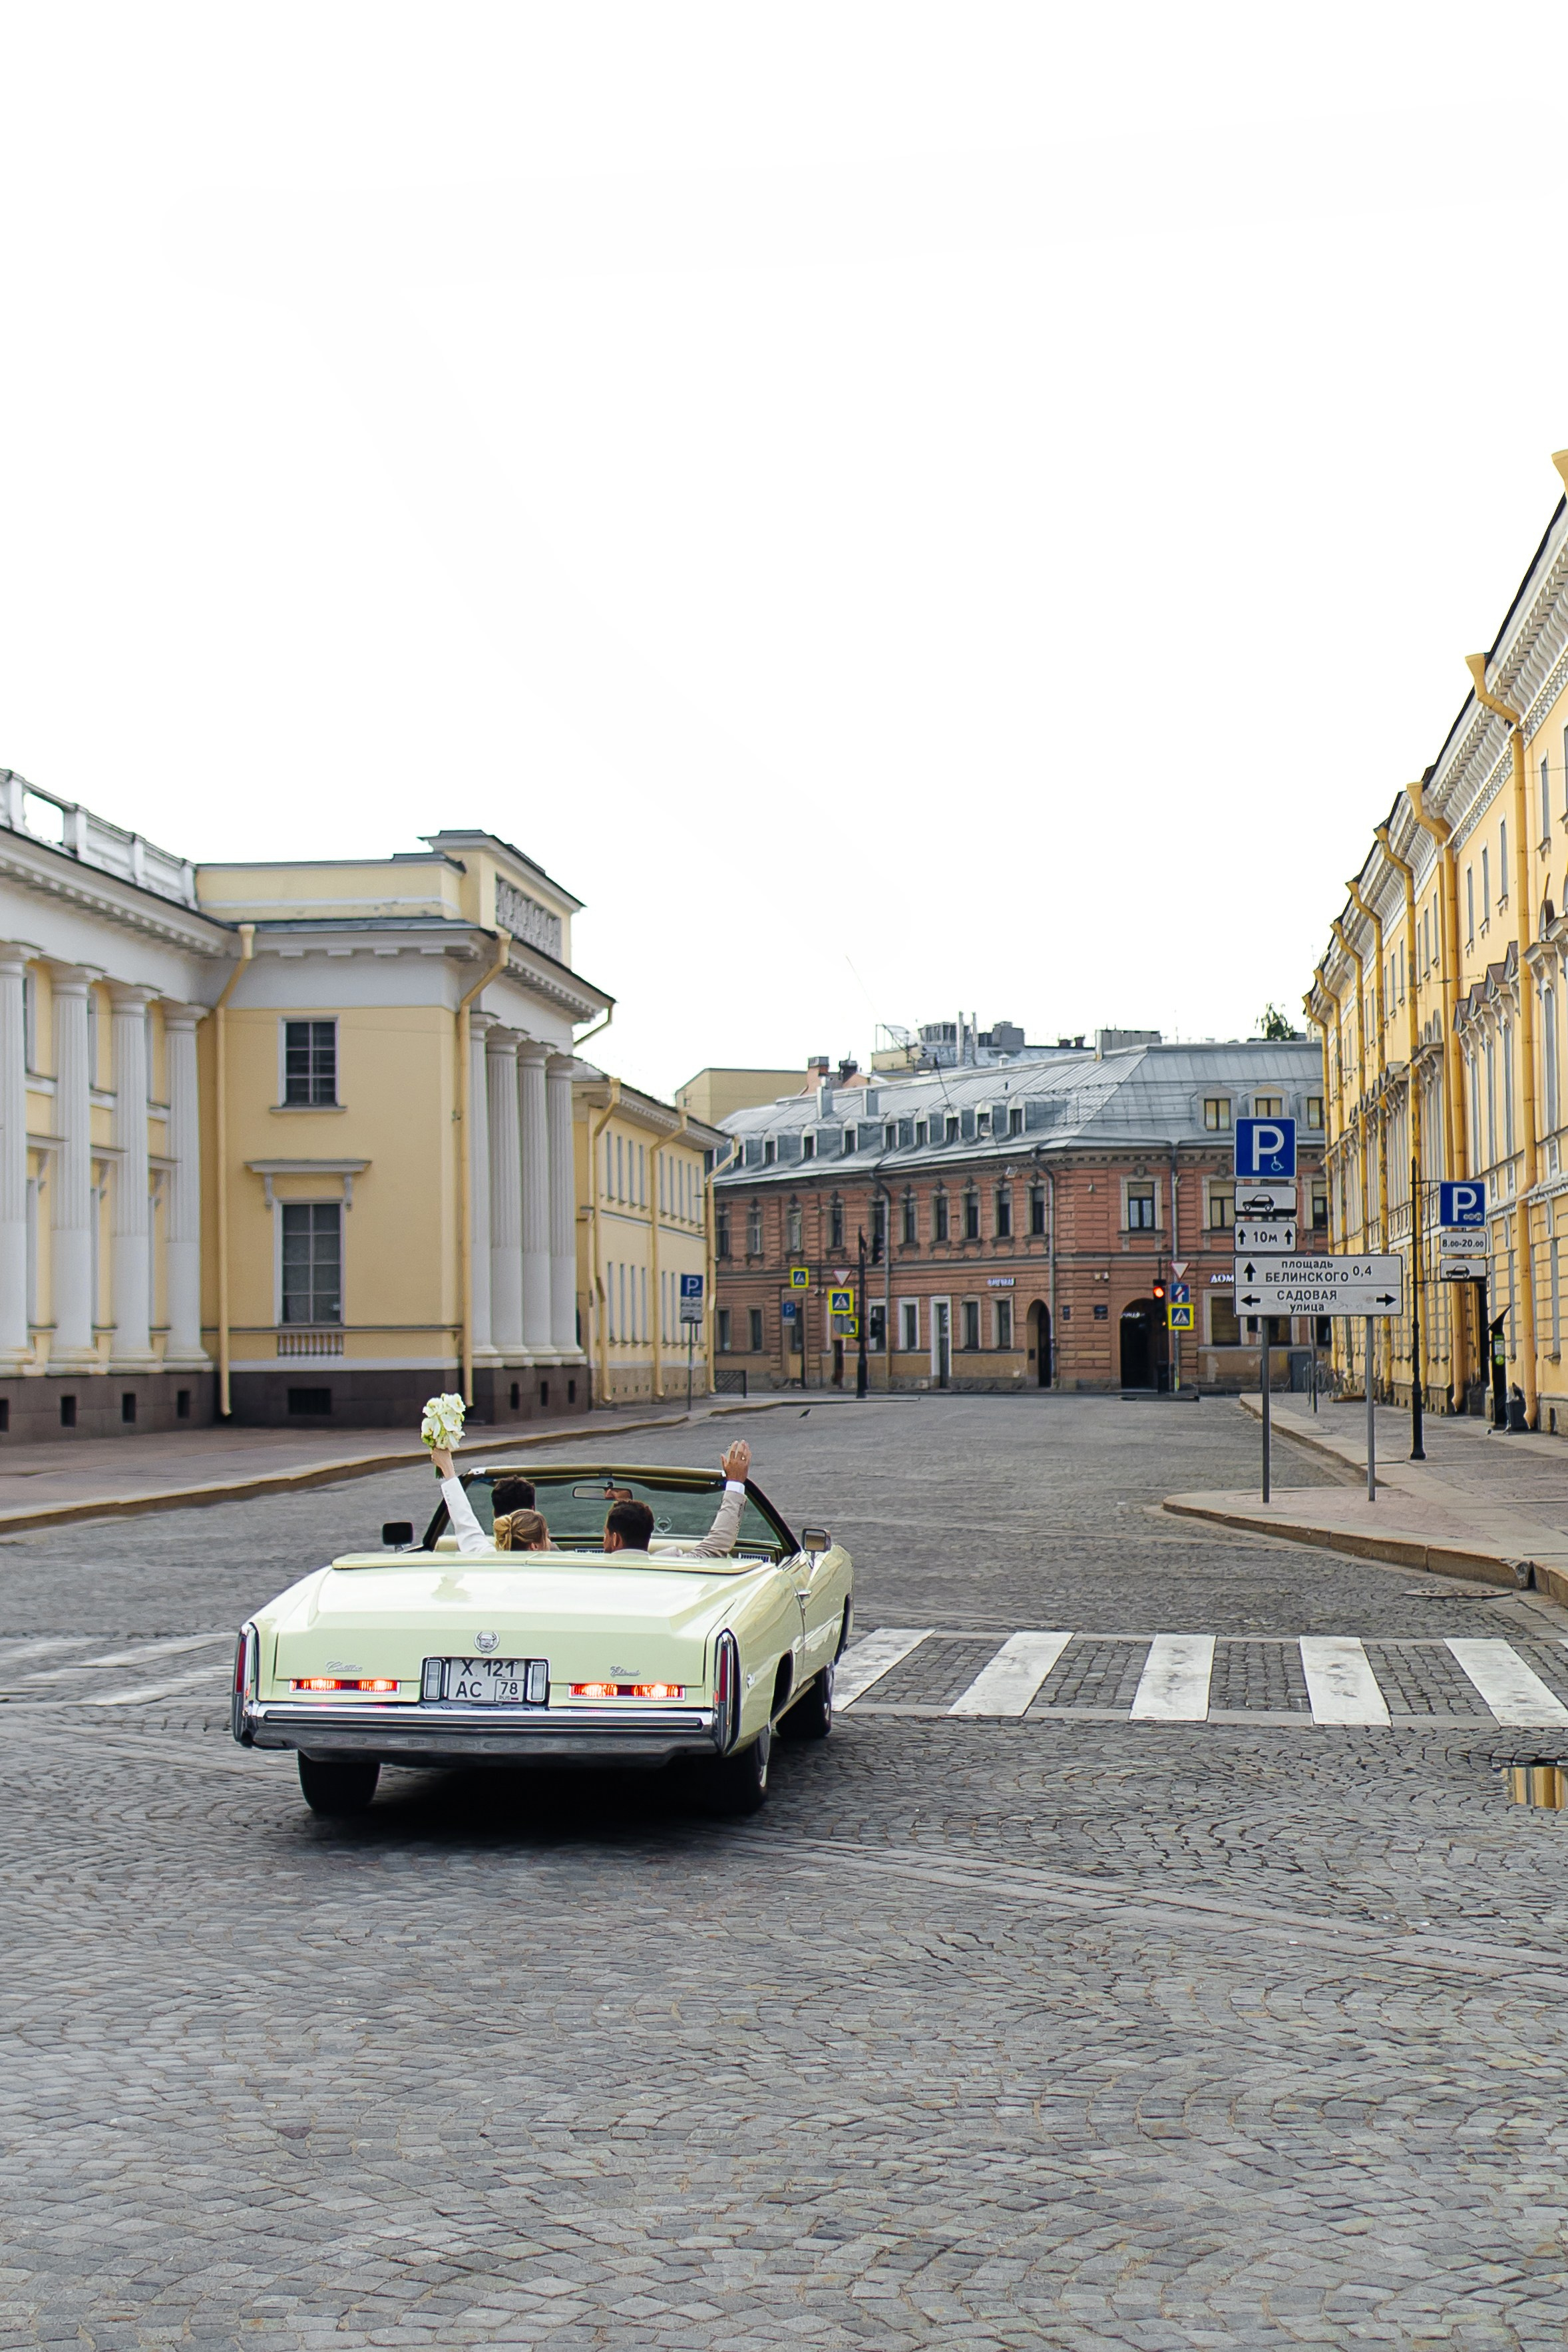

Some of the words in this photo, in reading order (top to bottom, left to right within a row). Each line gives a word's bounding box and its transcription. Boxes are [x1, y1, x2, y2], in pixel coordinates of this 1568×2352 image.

[1252, 1125, 1284, 1171] P
[1453, 1187, 1477, 1222] P
[1442, 1239, 1484, 1248] 8.00-20.00
[1281, 1261, 1334, 1269] площадь
[1265, 1272, 1349, 1282] БЕЛИНСКОГО
[1352, 1266, 1372, 1277] 0,4
[686, 1277, 699, 1295] P
[1276, 1290, 1337, 1301] САДОВАЯ
[1290, 1304, 1324, 1314] улица
[483, 1660, 515, 1677] 121
[455, 1681, 483, 1698] AC
[500, 1682, 518, 1695] 78
